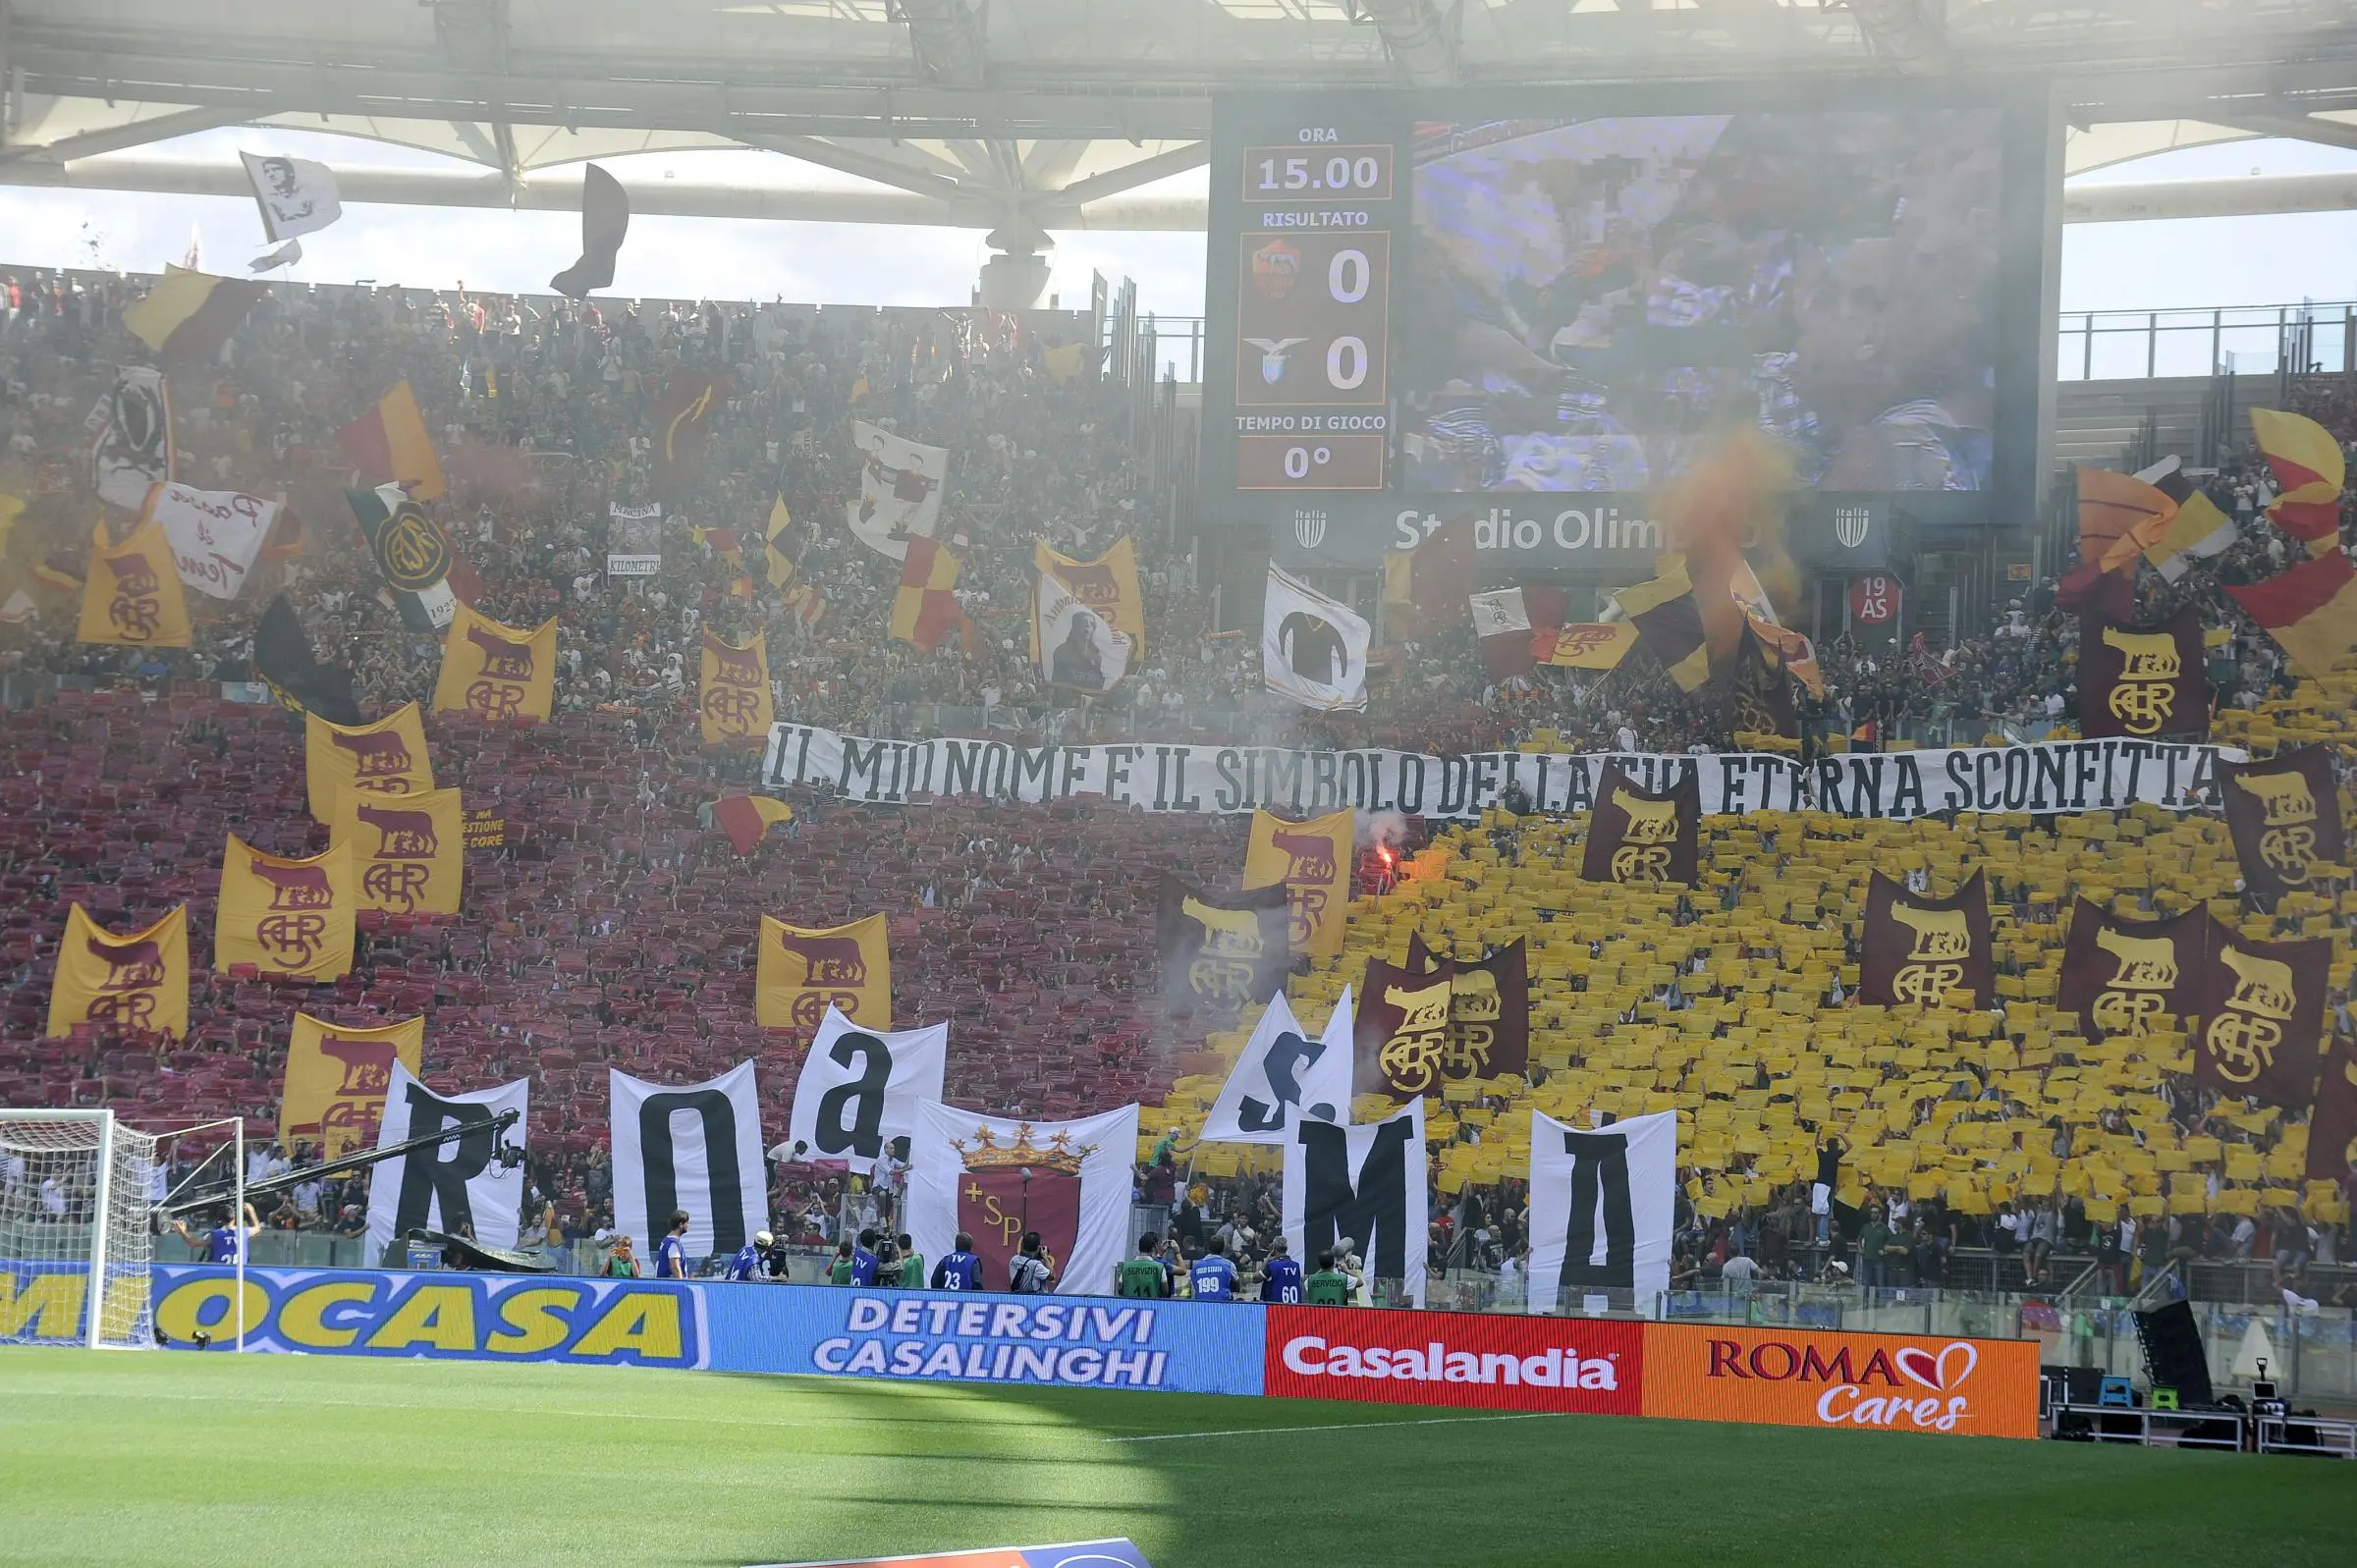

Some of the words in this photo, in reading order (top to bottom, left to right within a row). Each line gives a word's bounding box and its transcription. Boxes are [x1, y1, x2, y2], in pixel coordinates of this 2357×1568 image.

[1298, 128, 1338, 142] ORA
[1259, 156, 1379, 189] 15.00
[1263, 211, 1369, 227] RISULTATO
[1329, 248, 1370, 303] 0
[1327, 335, 1368, 390] 0
[1235, 415, 1295, 430] TEMPO
[1301, 415, 1323, 430] DI
[1327, 414, 1387, 430] GIOCO
[1295, 509, 1327, 519] Italia
[1836, 507, 1870, 517] Italia
[1396, 508, 1543, 550] Stdio
[1862, 577, 1886, 597] 19
[1860, 598, 1889, 620] AS
[770, 723, 814, 786] IL
[837, 736, 935, 804] MIO
[945, 739, 1087, 802] NOME
[1152, 745, 1199, 812] IL
[1215, 748, 1426, 817] SIMBOLO
[1720, 755, 1927, 815] ETERNA
[1945, 737, 2222, 813] SCONFITTA
[393, 1082, 494, 1239] R
[638, 1089, 747, 1267] O
[1297, 1114, 1415, 1278] M
[855, 1256, 868, 1270] TV
[952, 1254, 966, 1265] TV
[1126, 1267, 1158, 1275] SERVIZIO
[1283, 1267, 1297, 1276] TV
[1196, 1276, 1220, 1293] 199
[1281, 1285, 1298, 1304] 60
[1312, 1278, 1344, 1289] SERVIZIO
[848, 1297, 1155, 1343] DETERSIVI
[813, 1335, 1168, 1386] CASALINGHI
[1282, 1335, 1619, 1392] Casalandia
[1706, 1338, 1903, 1386] ROMA
[1816, 1384, 1977, 1432] Cares
